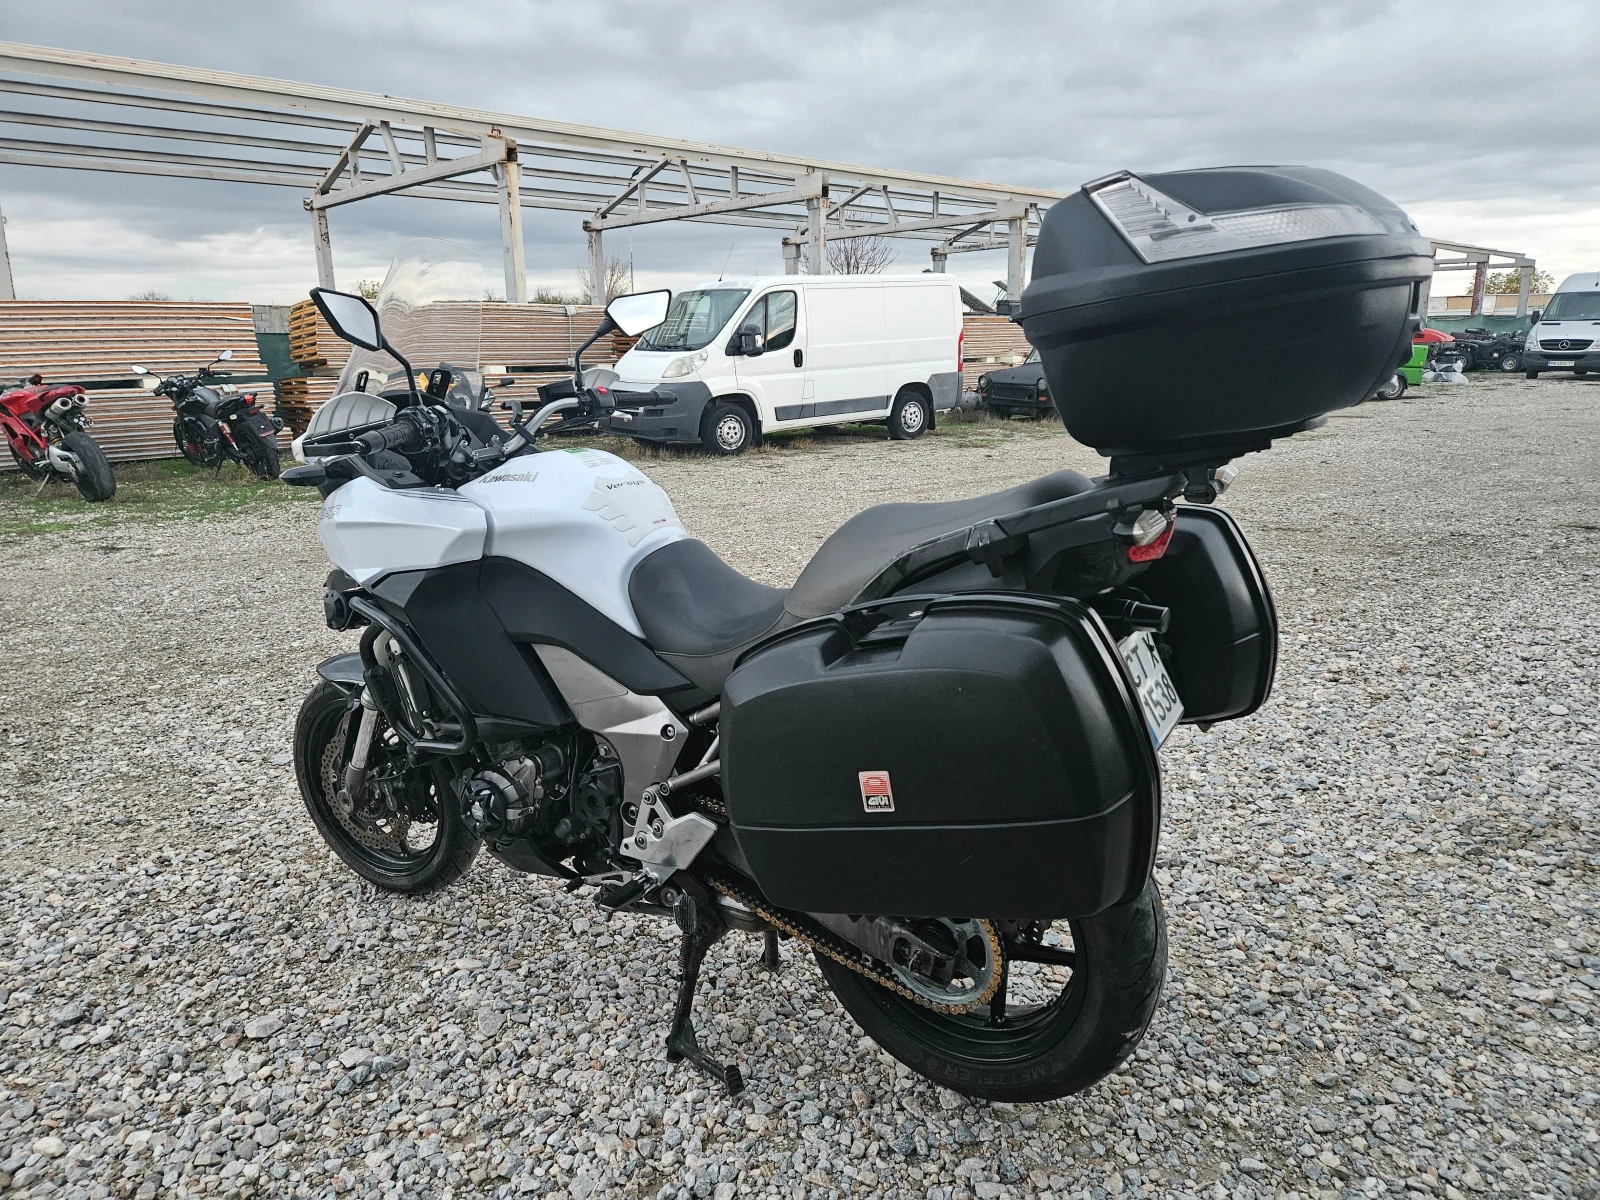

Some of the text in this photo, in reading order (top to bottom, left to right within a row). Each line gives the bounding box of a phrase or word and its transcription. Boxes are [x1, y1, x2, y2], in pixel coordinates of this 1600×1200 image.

[478, 471, 539, 484] Kawasaki
[607, 478, 645, 491] Versys
[1124, 632, 1160, 688] CT K
[1143, 672, 1177, 728] 1538
